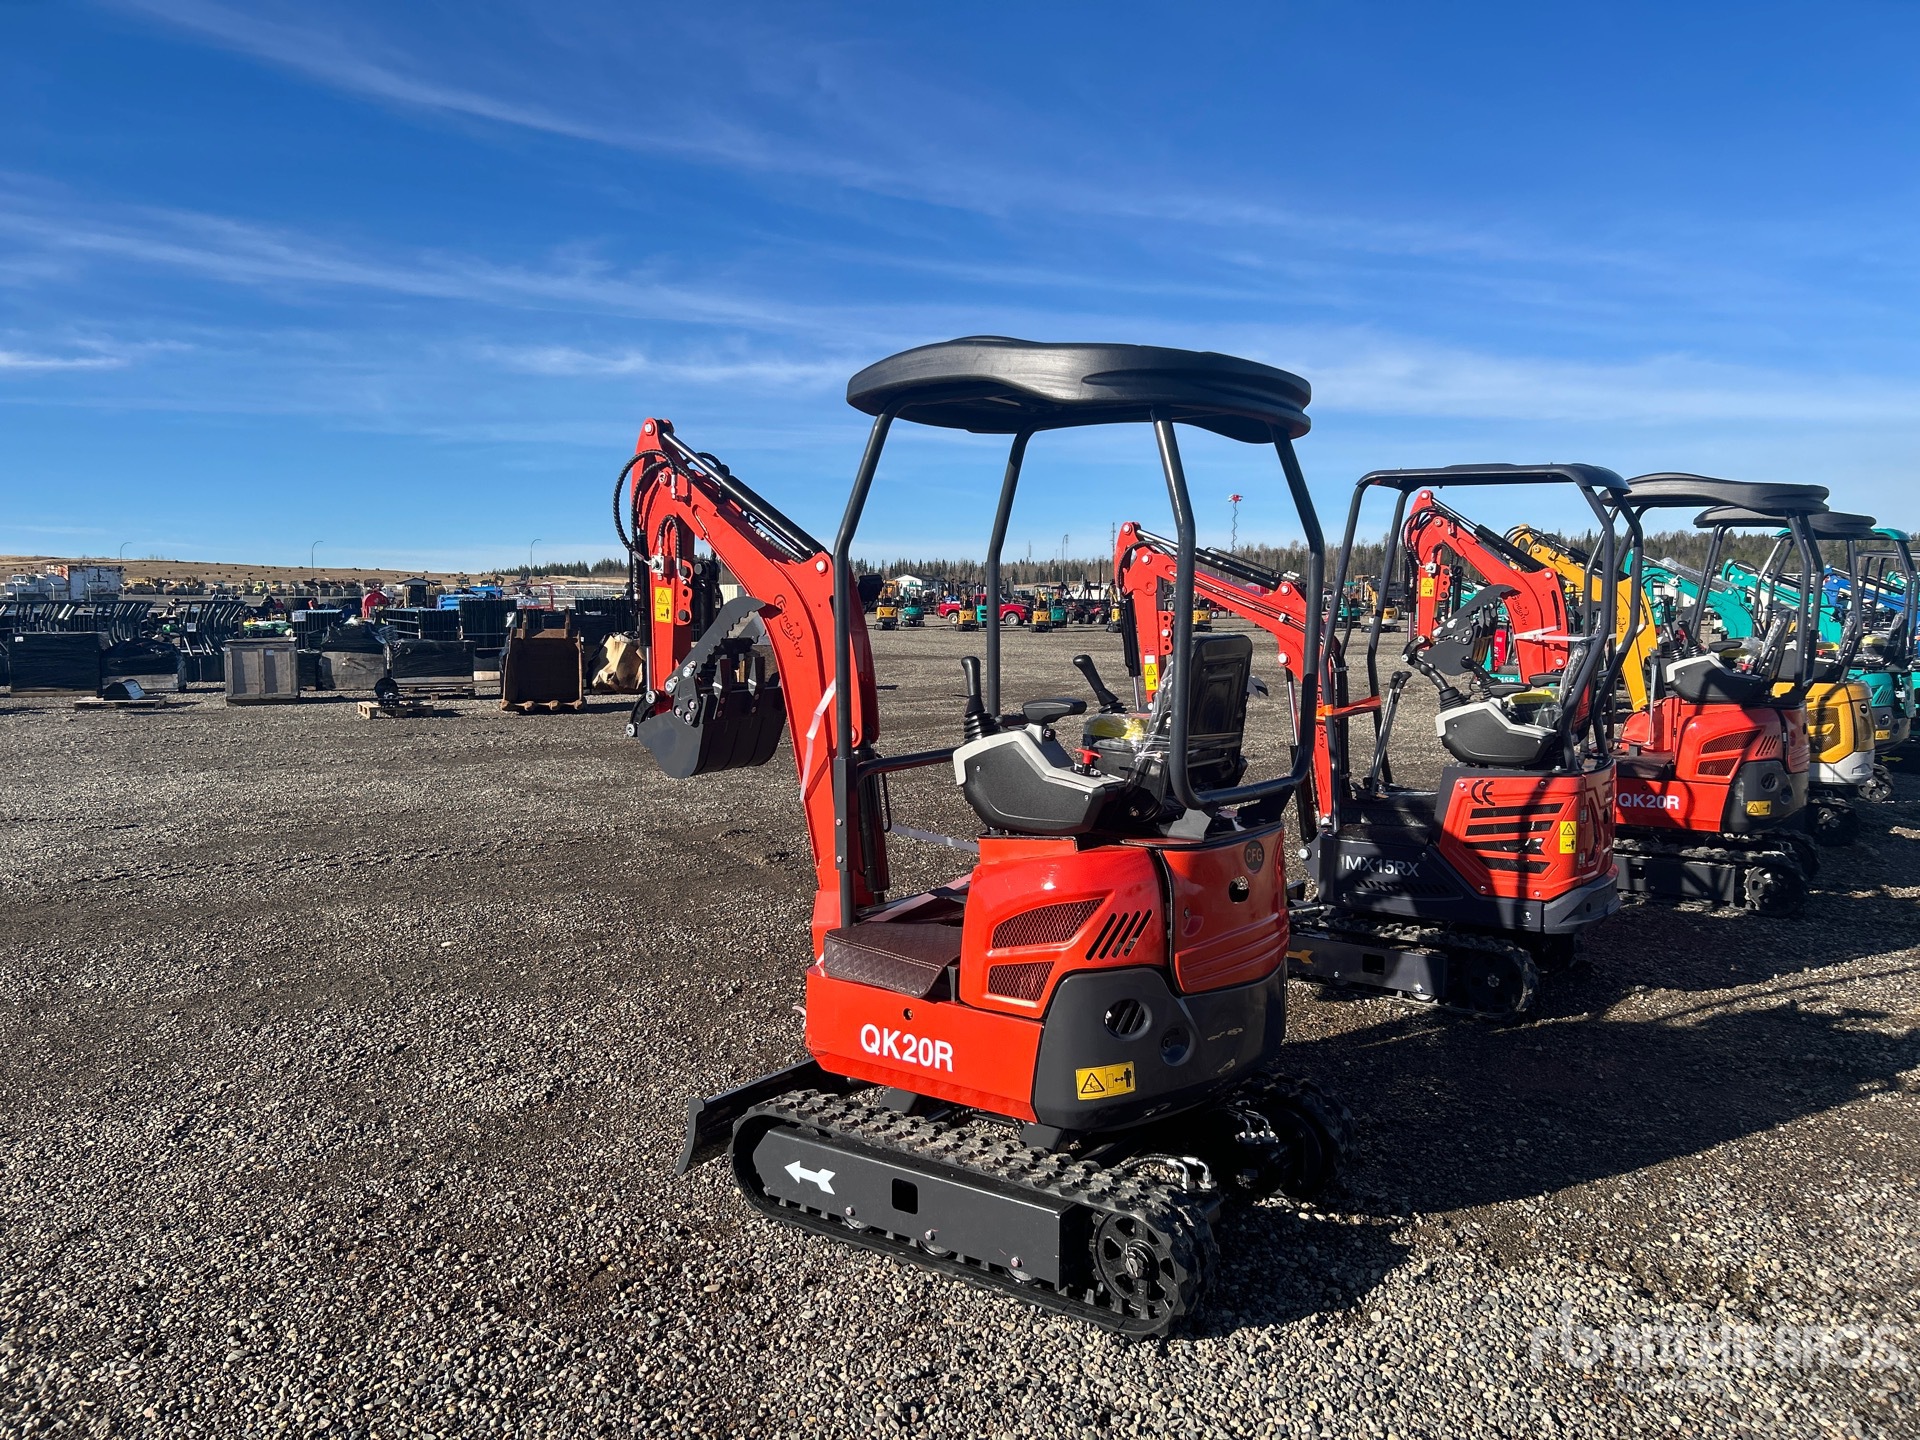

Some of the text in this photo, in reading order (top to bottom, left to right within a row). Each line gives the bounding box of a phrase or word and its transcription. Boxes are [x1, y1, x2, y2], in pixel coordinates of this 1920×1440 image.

[1618, 792, 1680, 810] QK20R
[1246, 847, 1263, 863] CFG
[1345, 855, 1420, 878] MX15RX
[860, 1023, 953, 1073] QK20R
